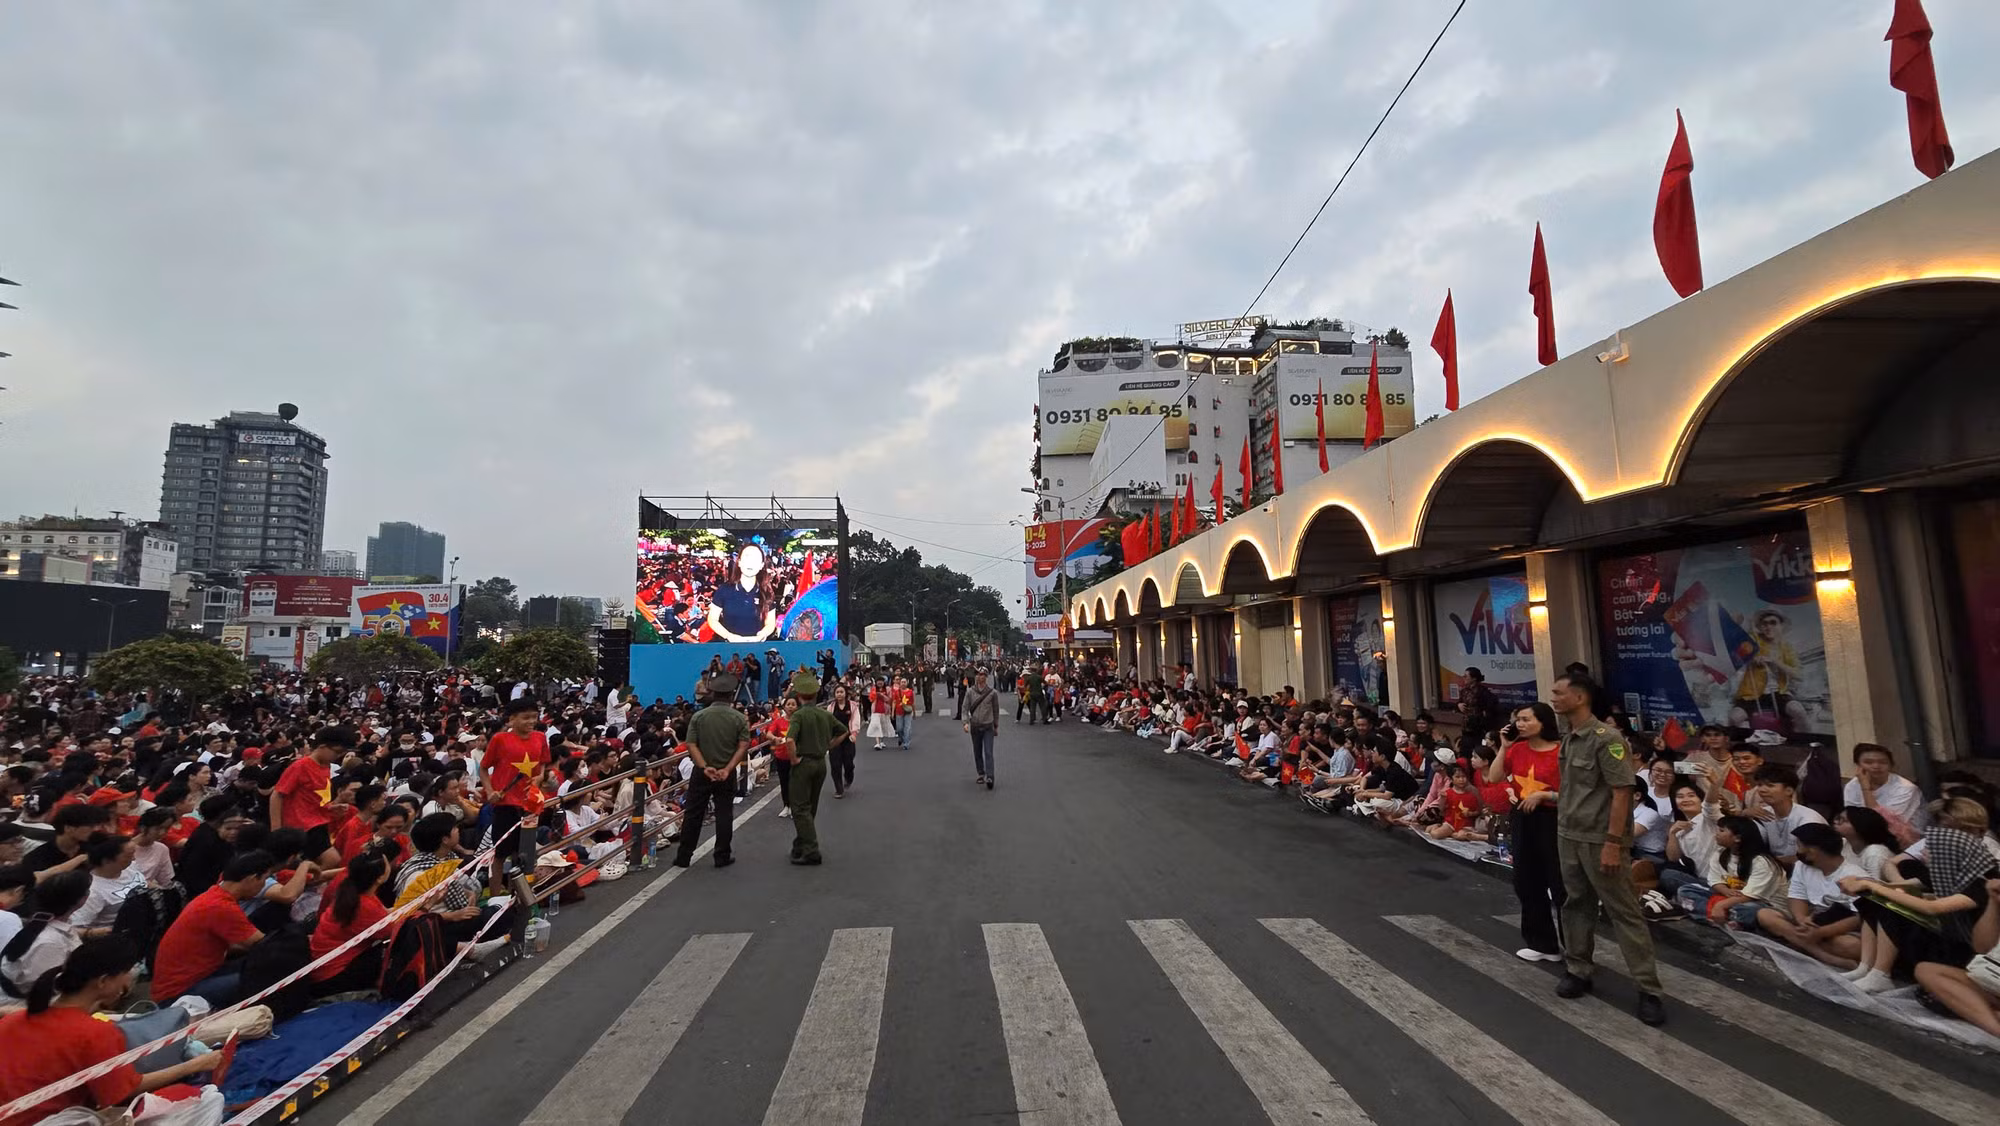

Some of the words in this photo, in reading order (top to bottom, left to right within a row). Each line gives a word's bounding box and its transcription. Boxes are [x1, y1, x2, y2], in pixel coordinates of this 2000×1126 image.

[1184, 315, 1264, 334] SILVERLAND
[1290, 394, 1328, 406] 0931
[1333, 394, 1355, 406] 80
[1386, 394, 1405, 405] 85
[1046, 408, 1090, 425] 0931
[1159, 404, 1182, 418] 85
[428, 593, 449, 603] 30.4
[1449, 591, 1535, 655] Vikki
[1650, 622, 1665, 635] lai
[1490, 659, 1516, 671] Digital
